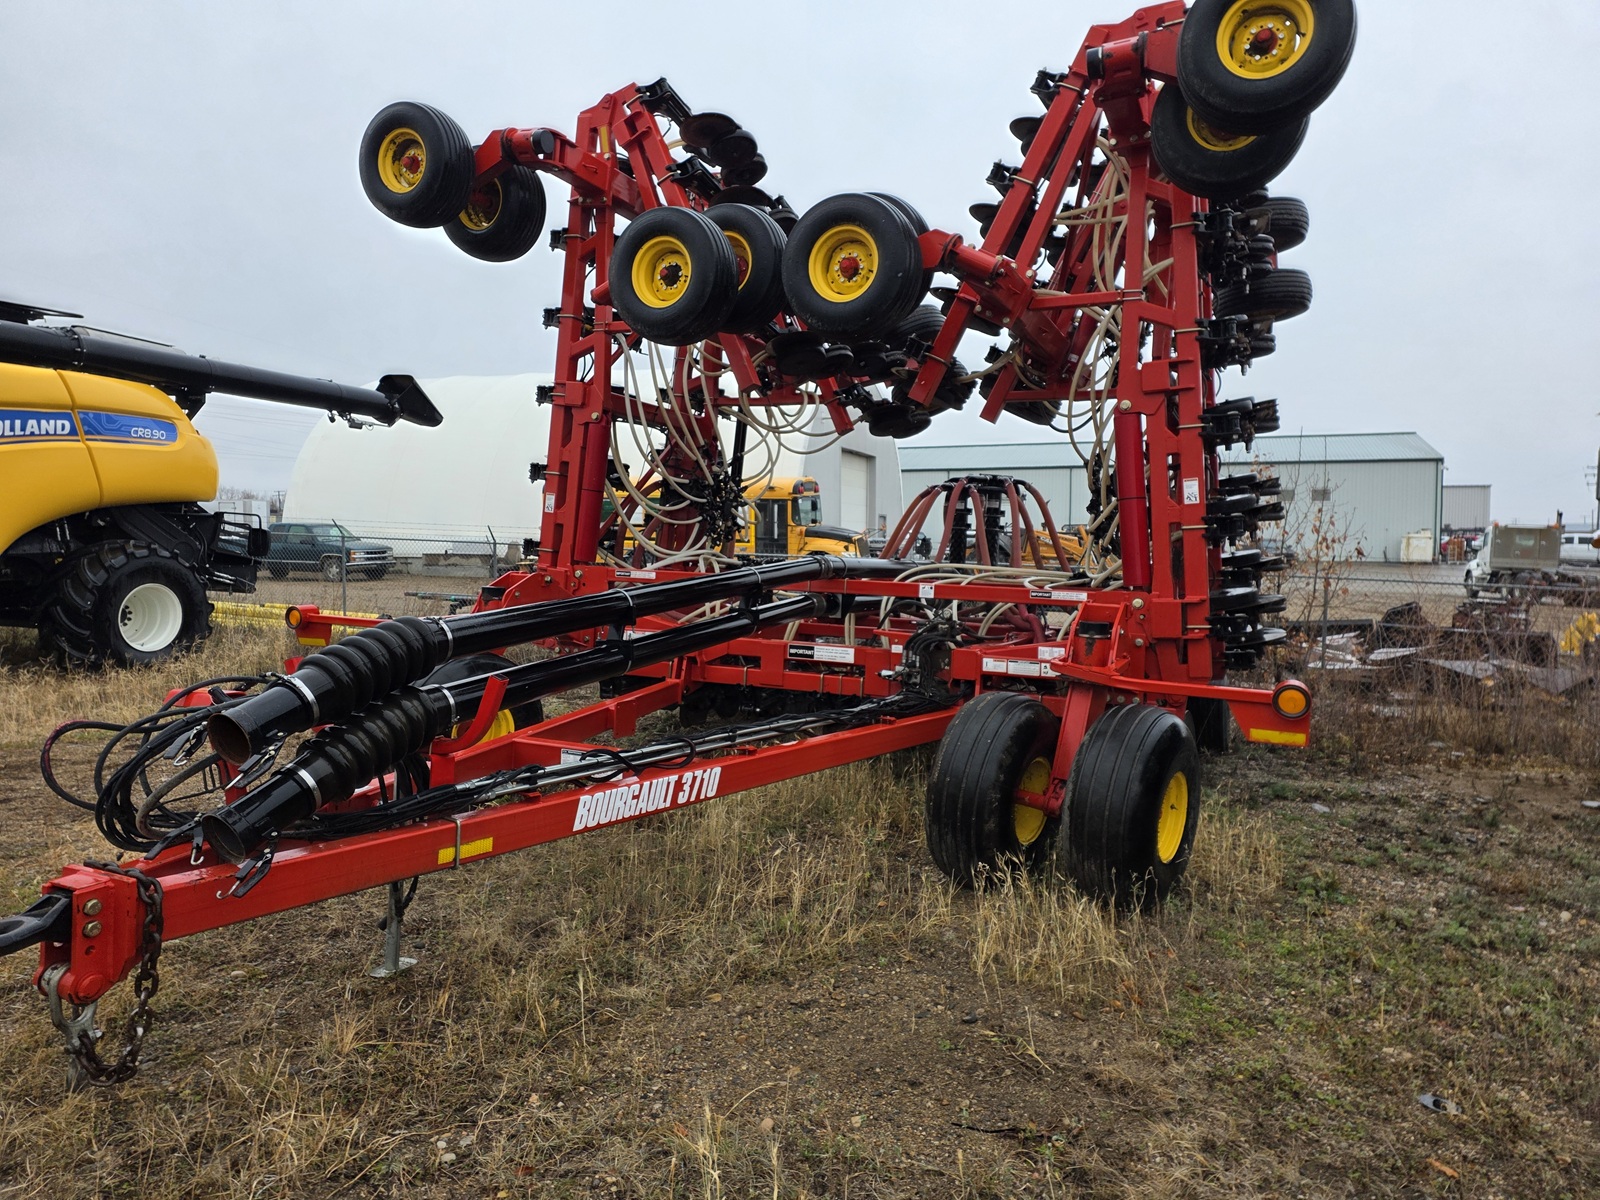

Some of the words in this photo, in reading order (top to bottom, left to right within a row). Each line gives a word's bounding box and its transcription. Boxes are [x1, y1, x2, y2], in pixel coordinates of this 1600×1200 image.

[0, 419, 71, 436] LLAND
[131, 427, 166, 440] CR8.90
[573, 775, 679, 831] BOURGAULT
[677, 766, 722, 804] 3710
